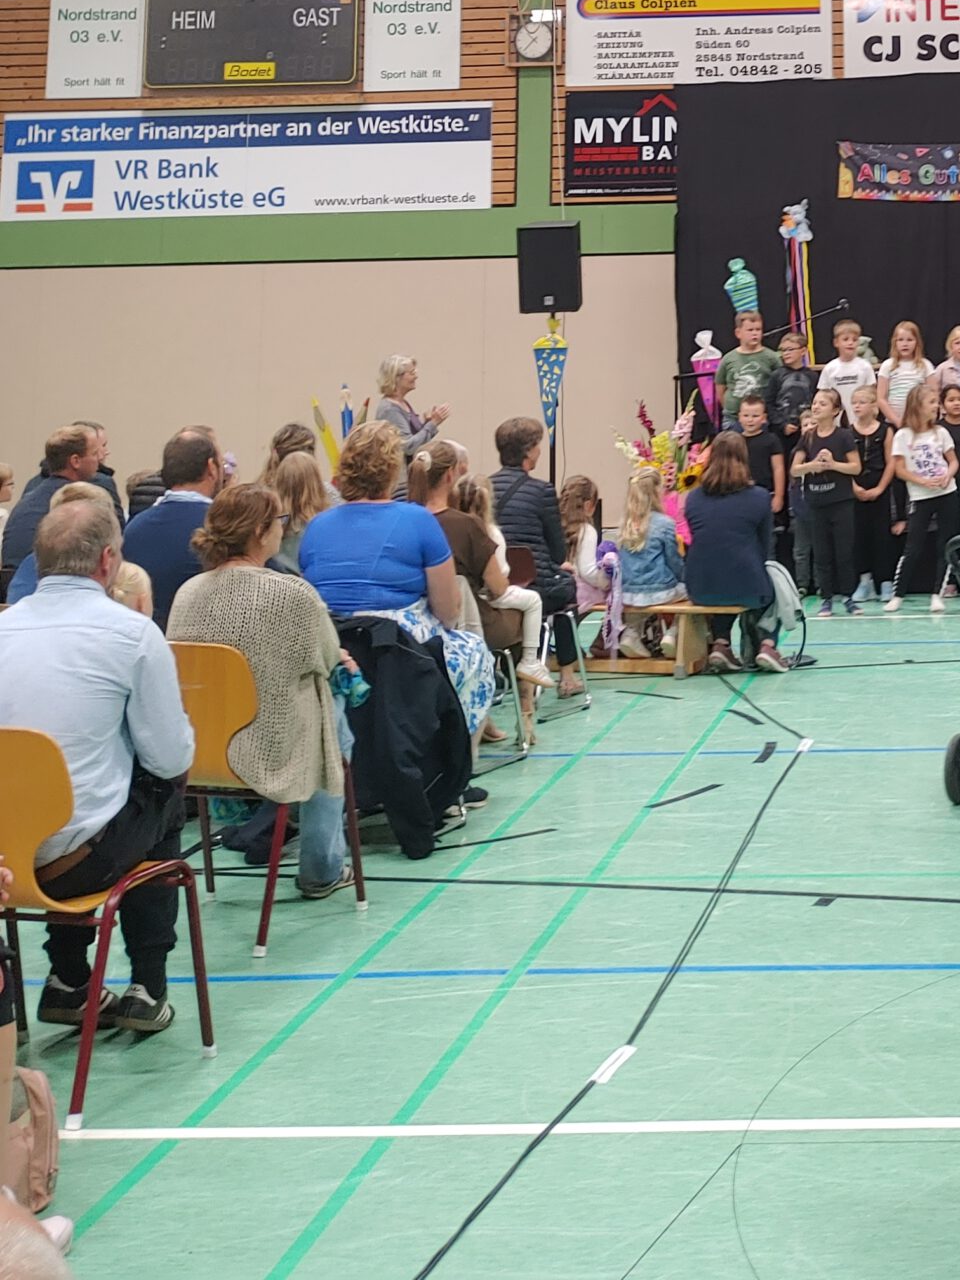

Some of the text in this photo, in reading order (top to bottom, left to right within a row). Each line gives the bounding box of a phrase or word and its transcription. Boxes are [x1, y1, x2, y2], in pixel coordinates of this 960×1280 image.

[373, 0, 452, 14] Nordstrand
[58, 8, 137, 21] Nordstrand
[172, 10, 215, 30] HEIM
[293, 7, 341, 27] GAST
[387, 22, 440, 35] 03 e.V.
[695, 23, 821, 36] Inh. Andreas Colpien
[70, 30, 123, 43] 03 e.V.
[695, 38, 750, 49] Süden 60
[863, 35, 901, 63] CJ
[695, 51, 805, 63] 25845 Nordstrand
[228, 65, 273, 77] Bodet
[381, 70, 442, 80] Sport hält fit
[695, 66, 724, 78] Tel.
[729, 65, 778, 76] 04842
[794, 63, 823, 75] 205
[64, 77, 125, 88] Sport hält fit
[61, 122, 131, 143] starker
[139, 119, 278, 143] Finanzpartner
[286, 122, 311, 136] an
[317, 117, 351, 136] der
[642, 145, 678, 161] BA
[115, 156, 219, 180] VR Bank
[857, 163, 911, 185] Alles
[113, 186, 286, 211] Westküste eG
[314, 192, 476, 207] www.vrbank-westkueste.de
